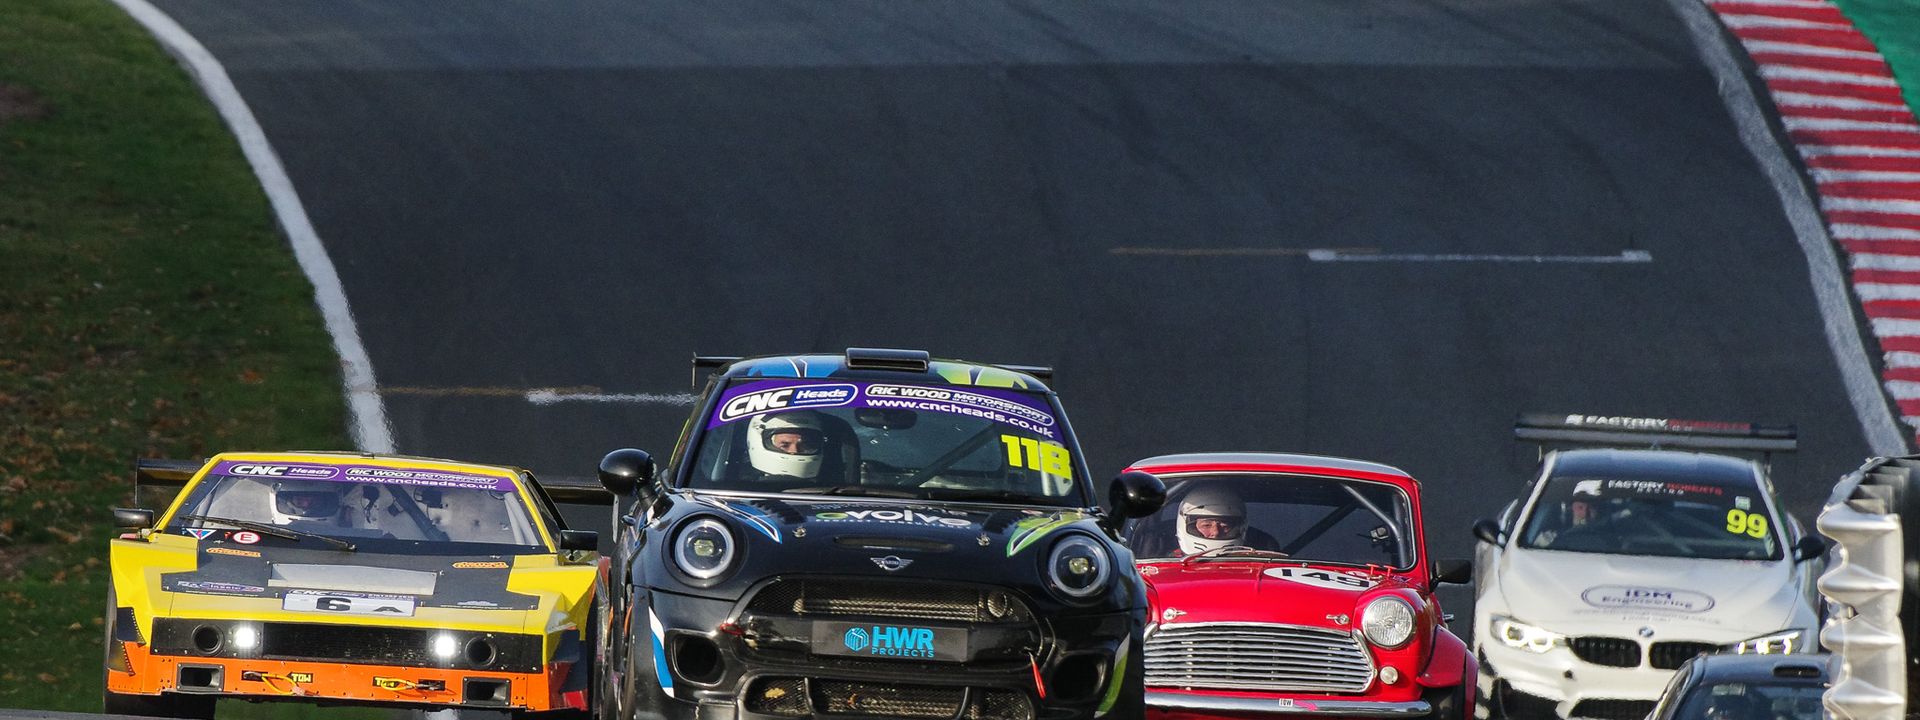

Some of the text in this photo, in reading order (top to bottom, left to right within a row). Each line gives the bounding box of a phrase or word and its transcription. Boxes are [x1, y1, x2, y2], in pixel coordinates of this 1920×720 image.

[726, 389, 849, 417] CNC Heads
[871, 386, 1052, 422] RIC WOOD MOTORSPORT
[866, 399, 1053, 438] www.cncheads.co.uk
[1586, 415, 1668, 428] FACTORY
[1001, 434, 1071, 480] 118
[234, 465, 332, 476] CNC Heads
[350, 468, 370, 476] RIC
[373, 470, 413, 478] WOOD
[345, 477, 497, 490] www.cncheads.co.uk
[1608, 479, 1664, 489] FACTORY
[816, 510, 972, 526] evolve
[1727, 509, 1768, 539] 99
[1282, 569, 1370, 587] 149
[1626, 589, 1672, 600] IDM
[316, 597, 352, 611] 6
[872, 626, 934, 651] HWR
[871, 648, 935, 658] PROJECTS
[291, 673, 311, 682] TOW
